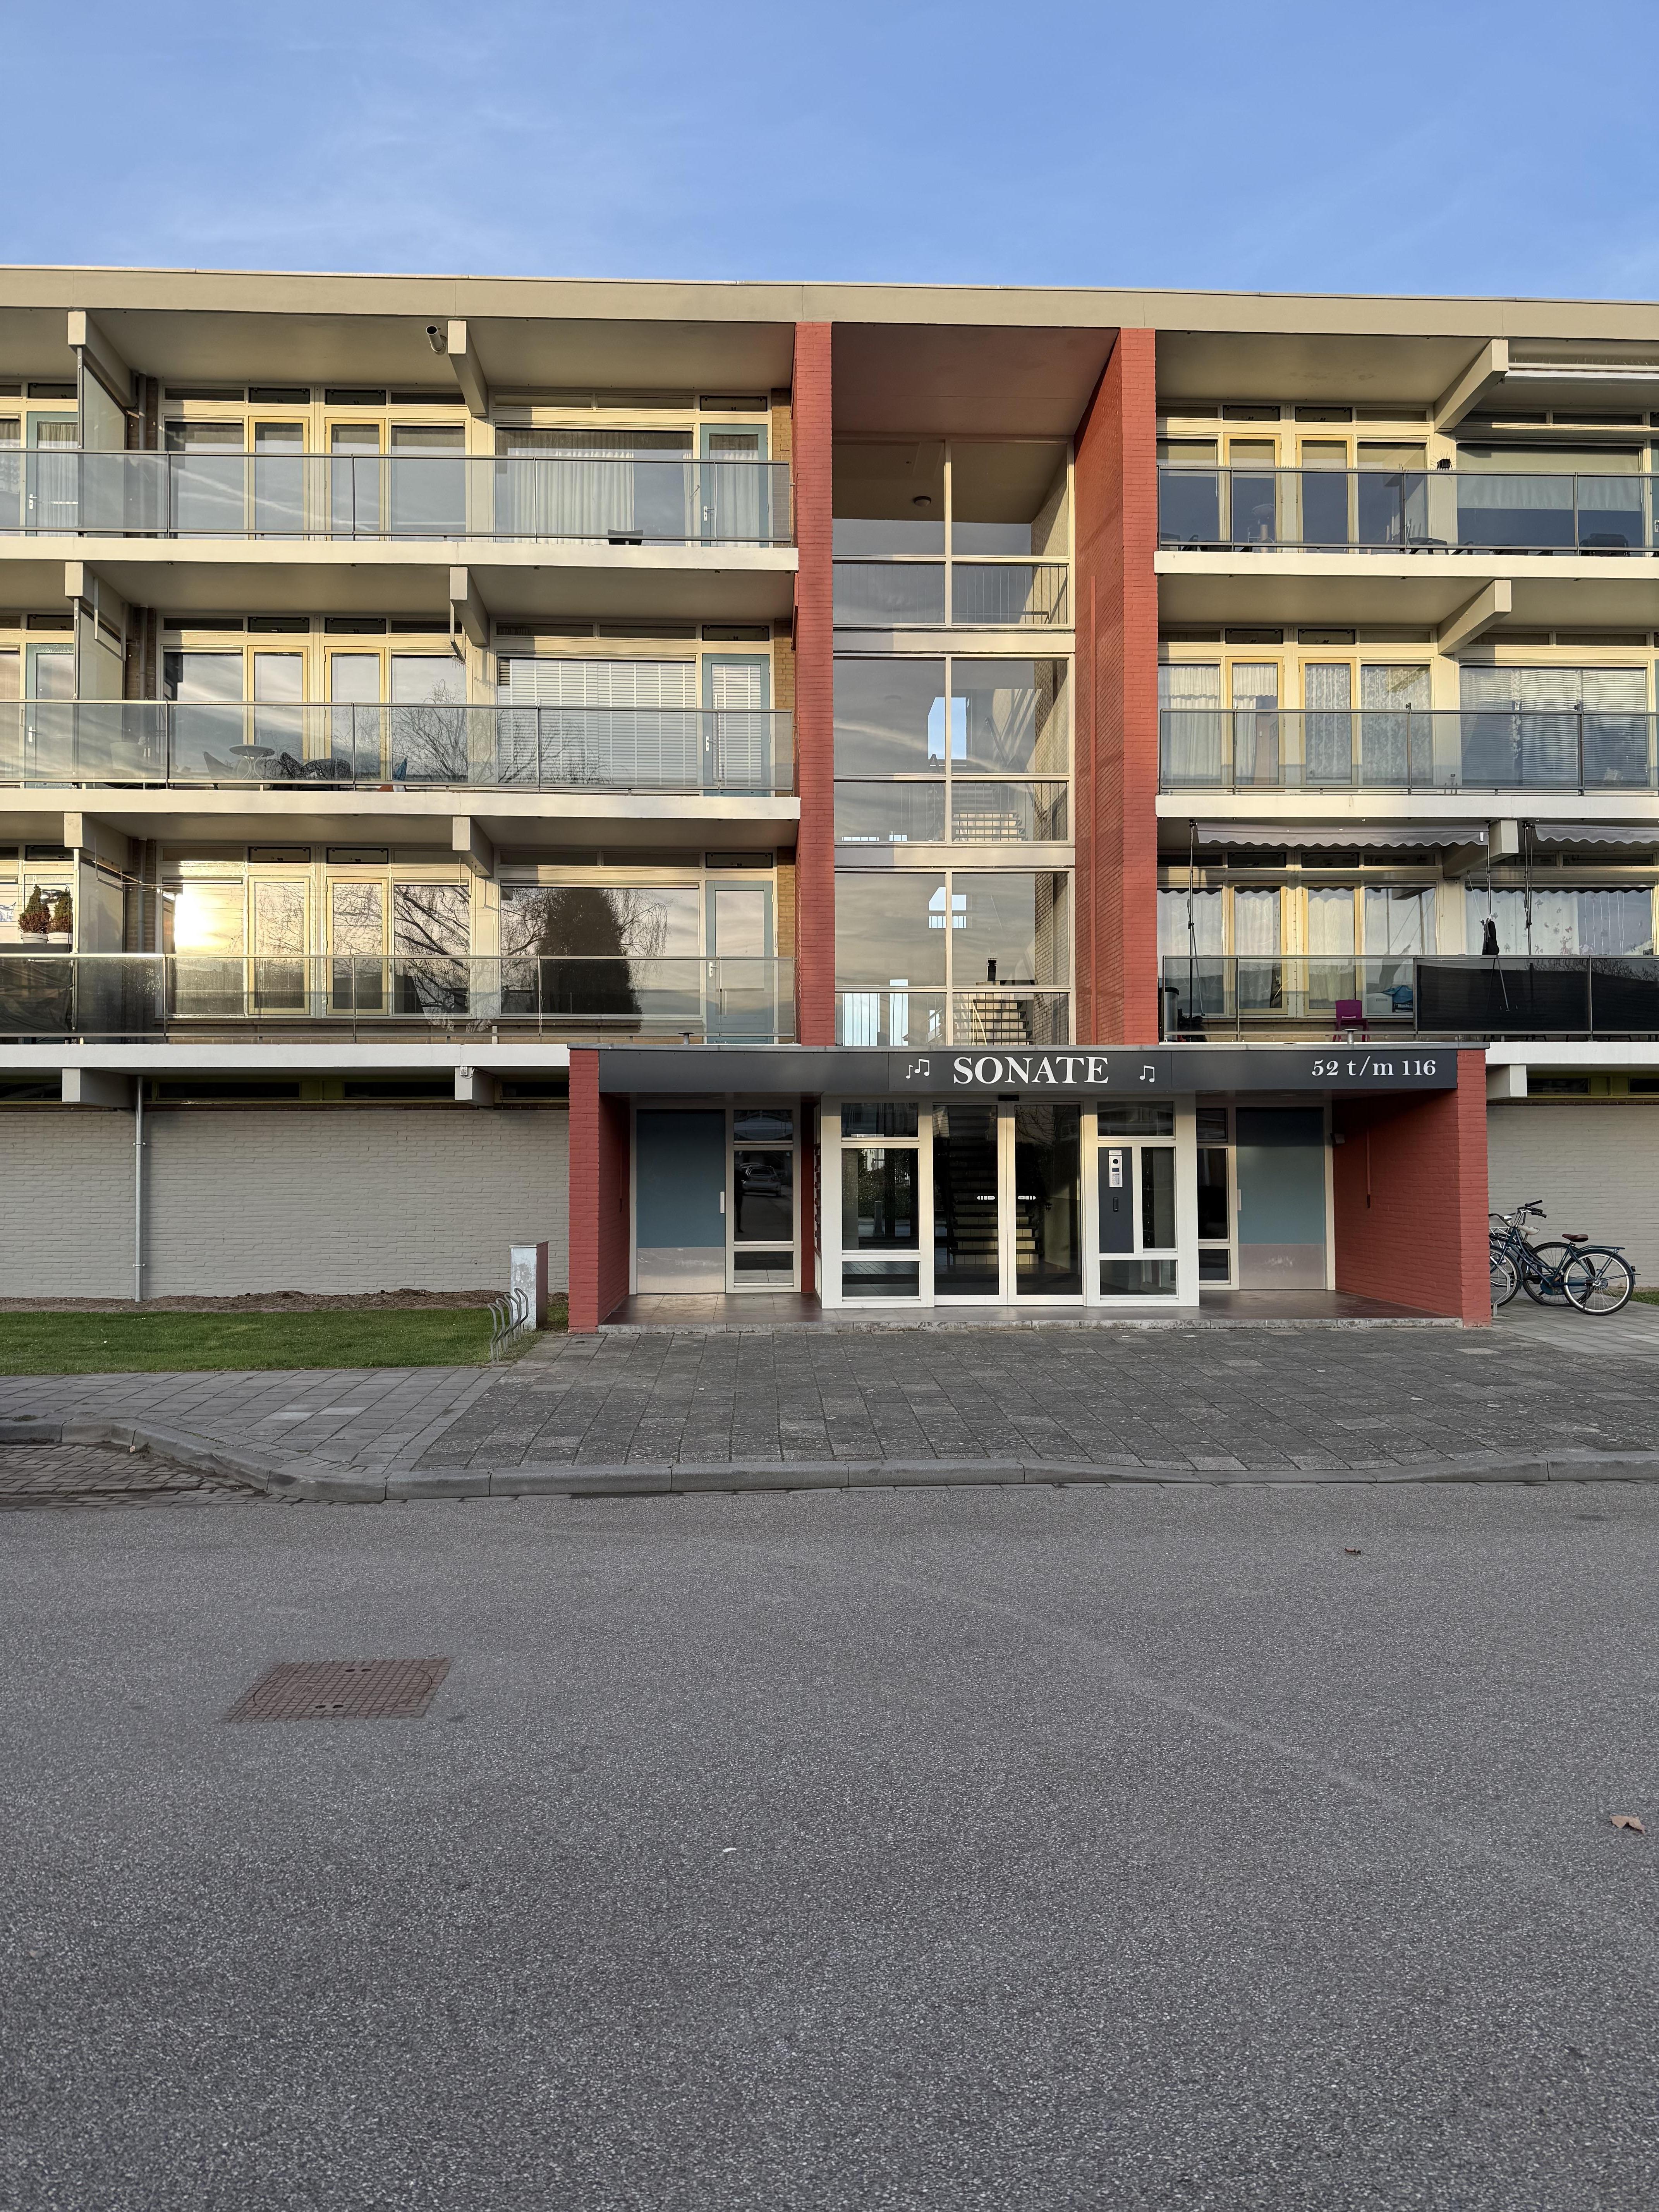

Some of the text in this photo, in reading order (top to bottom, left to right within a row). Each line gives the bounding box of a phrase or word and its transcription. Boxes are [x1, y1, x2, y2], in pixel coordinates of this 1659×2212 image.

[953, 1056, 1109, 1084] SONATE
[1312, 1056, 1436, 1076] 52 t/m 116
